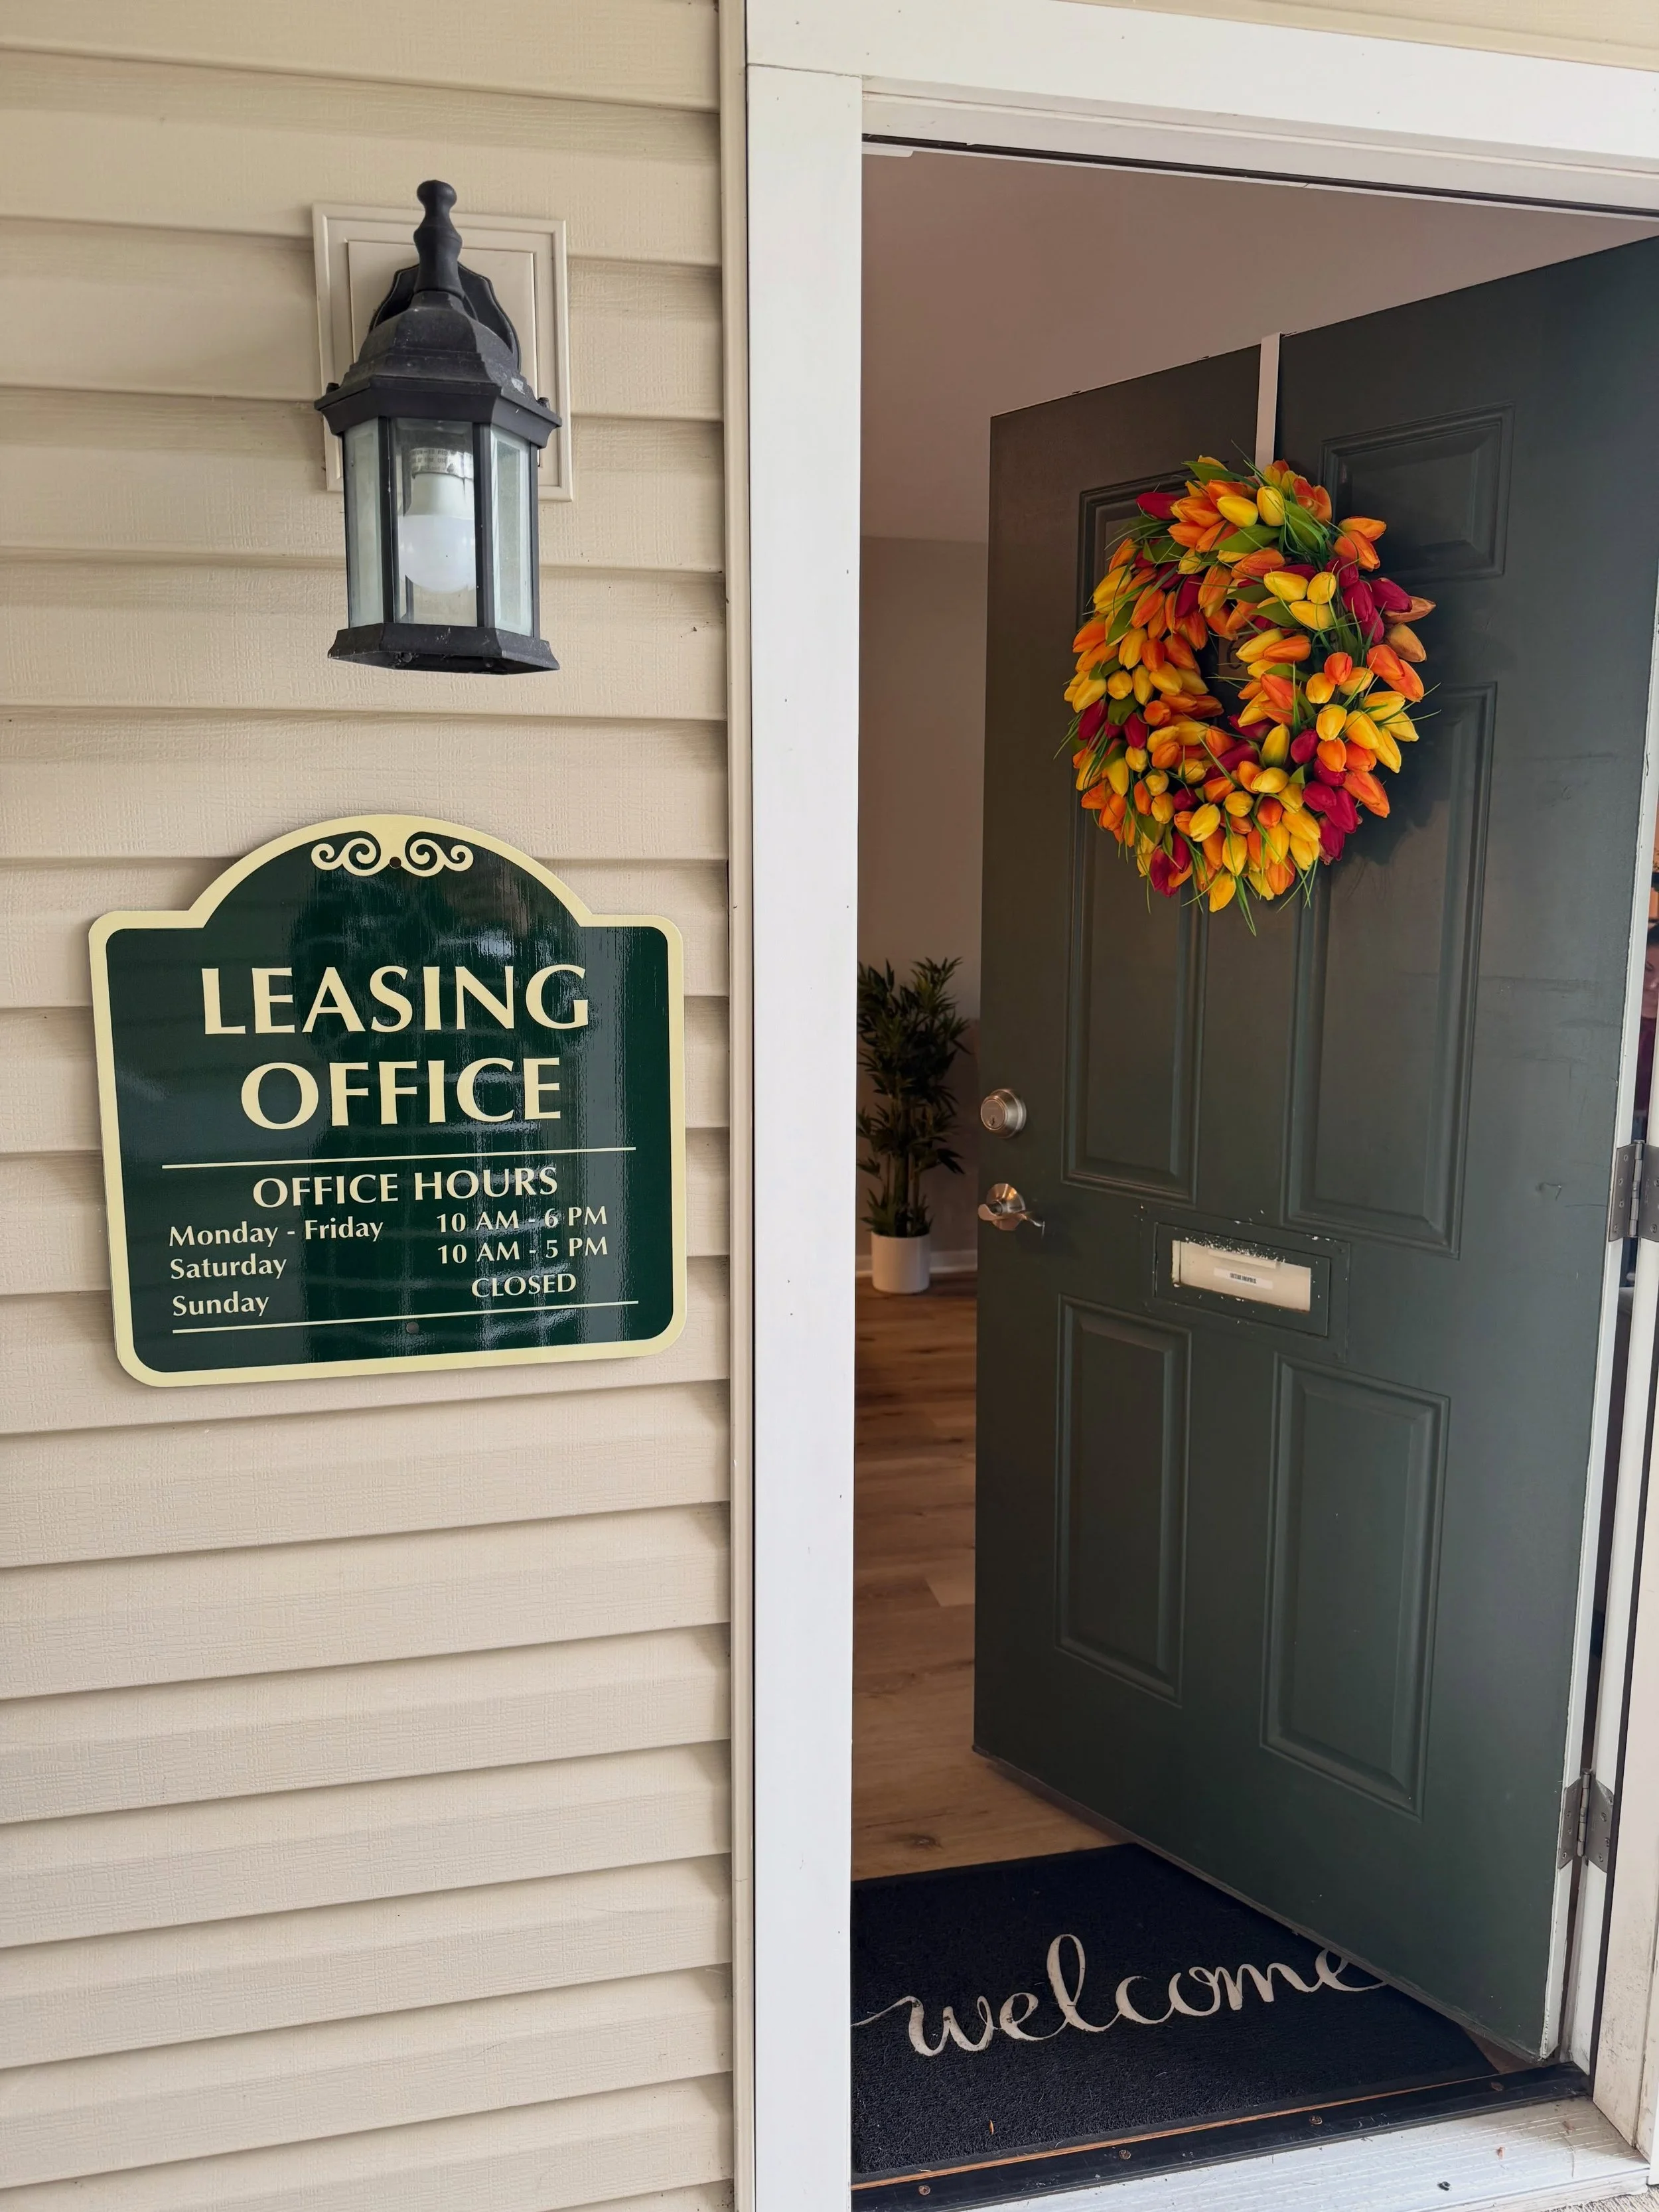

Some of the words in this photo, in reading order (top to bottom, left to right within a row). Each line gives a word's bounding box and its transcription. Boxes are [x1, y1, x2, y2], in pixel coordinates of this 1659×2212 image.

[201, 964, 589, 1035] LEASING
[241, 1057, 561, 1130] OFFICE
[253, 1173, 398, 1208] OFFICE
[414, 1166, 557, 1201] HOURS
[169, 1220, 278, 1248] Monday
[305, 1216, 384, 1242] Friday
[437, 1213, 466, 1232] 10
[475, 1210, 520, 1231] AM
[544, 1208, 559, 1228] 6
[568, 1205, 607, 1226] PM
[170, 1253, 287, 1280] Saturday
[438, 1244, 467, 1264] 10
[476, 1241, 520, 1262] AM
[545, 1239, 558, 1258] 5
[569, 1236, 608, 1258] PM
[173, 1291, 269, 1317] Sunday
[471, 1273, 576, 1297] CLOSED
[851, 1934, 1387, 2057] welcome
